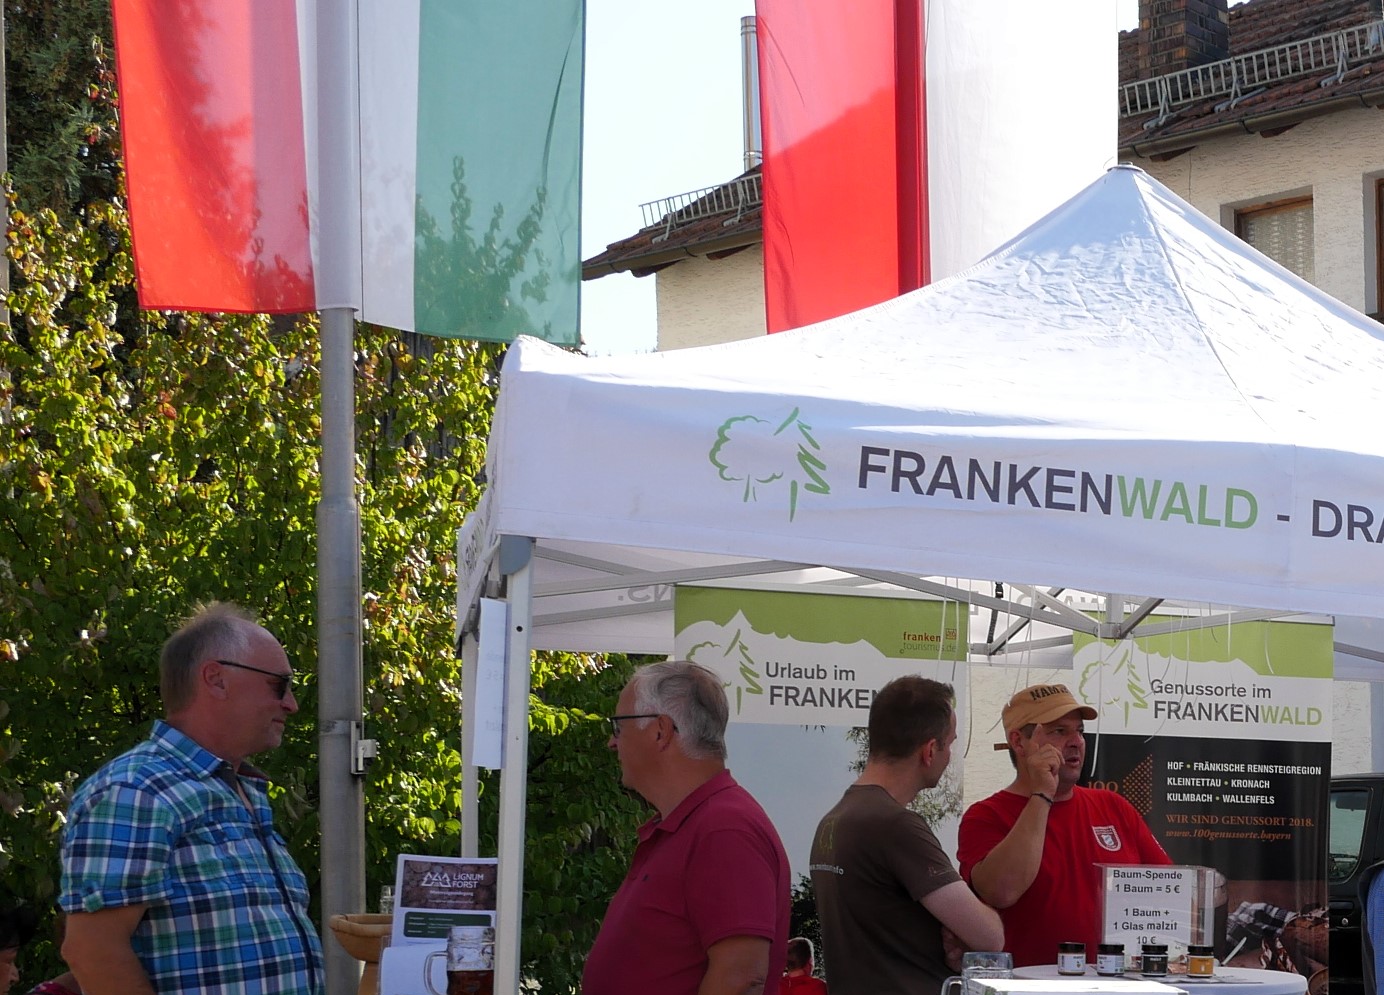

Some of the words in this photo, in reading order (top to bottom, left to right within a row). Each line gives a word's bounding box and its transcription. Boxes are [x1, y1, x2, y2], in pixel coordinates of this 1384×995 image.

[858, 445, 1258, 529] FRANKENWALD
[903, 631, 942, 642] franken
[765, 661, 827, 680] Urlaub
[833, 665, 856, 681] im
[1150, 678, 1247, 698] Genussorte
[1252, 684, 1272, 699] im
[1153, 700, 1323, 726] FRANKENWALD
[1167, 761, 1184, 770] HOF
[1193, 761, 1246, 773] FRÄNKISCHE
[1247, 764, 1322, 775] RENNSTEIGREGION
[1167, 777, 1222, 788] KLEINTETTAU
[1231, 779, 1270, 789] KRONACH
[1166, 792, 1213, 803] KULMBACH
[1222, 794, 1275, 805] WALLENFELS
[1165, 814, 1189, 824] WIR
[1191, 815, 1219, 825] SIND
[1221, 815, 1286, 826] GENUSSORT
[1288, 817, 1315, 827] 2018.
[1165, 828, 1292, 842] www.100genussorte.bayern
[453, 873, 484, 881] LIGNUM
[1113, 869, 1183, 880] Baum-Spende
[452, 881, 479, 889] FORST
[1115, 883, 1120, 893] 1
[1123, 883, 1153, 893] Baum
[1165, 884, 1171, 893] 5
[1173, 884, 1181, 893] €
[1123, 908, 1129, 916] 1
[1132, 908, 1161, 917] Baum
[1113, 921, 1118, 930] 1
[1121, 921, 1144, 931] Glas
[1146, 920, 1178, 931] malzit
[1136, 935, 1147, 944] 10
[1150, 935, 1157, 944] €
